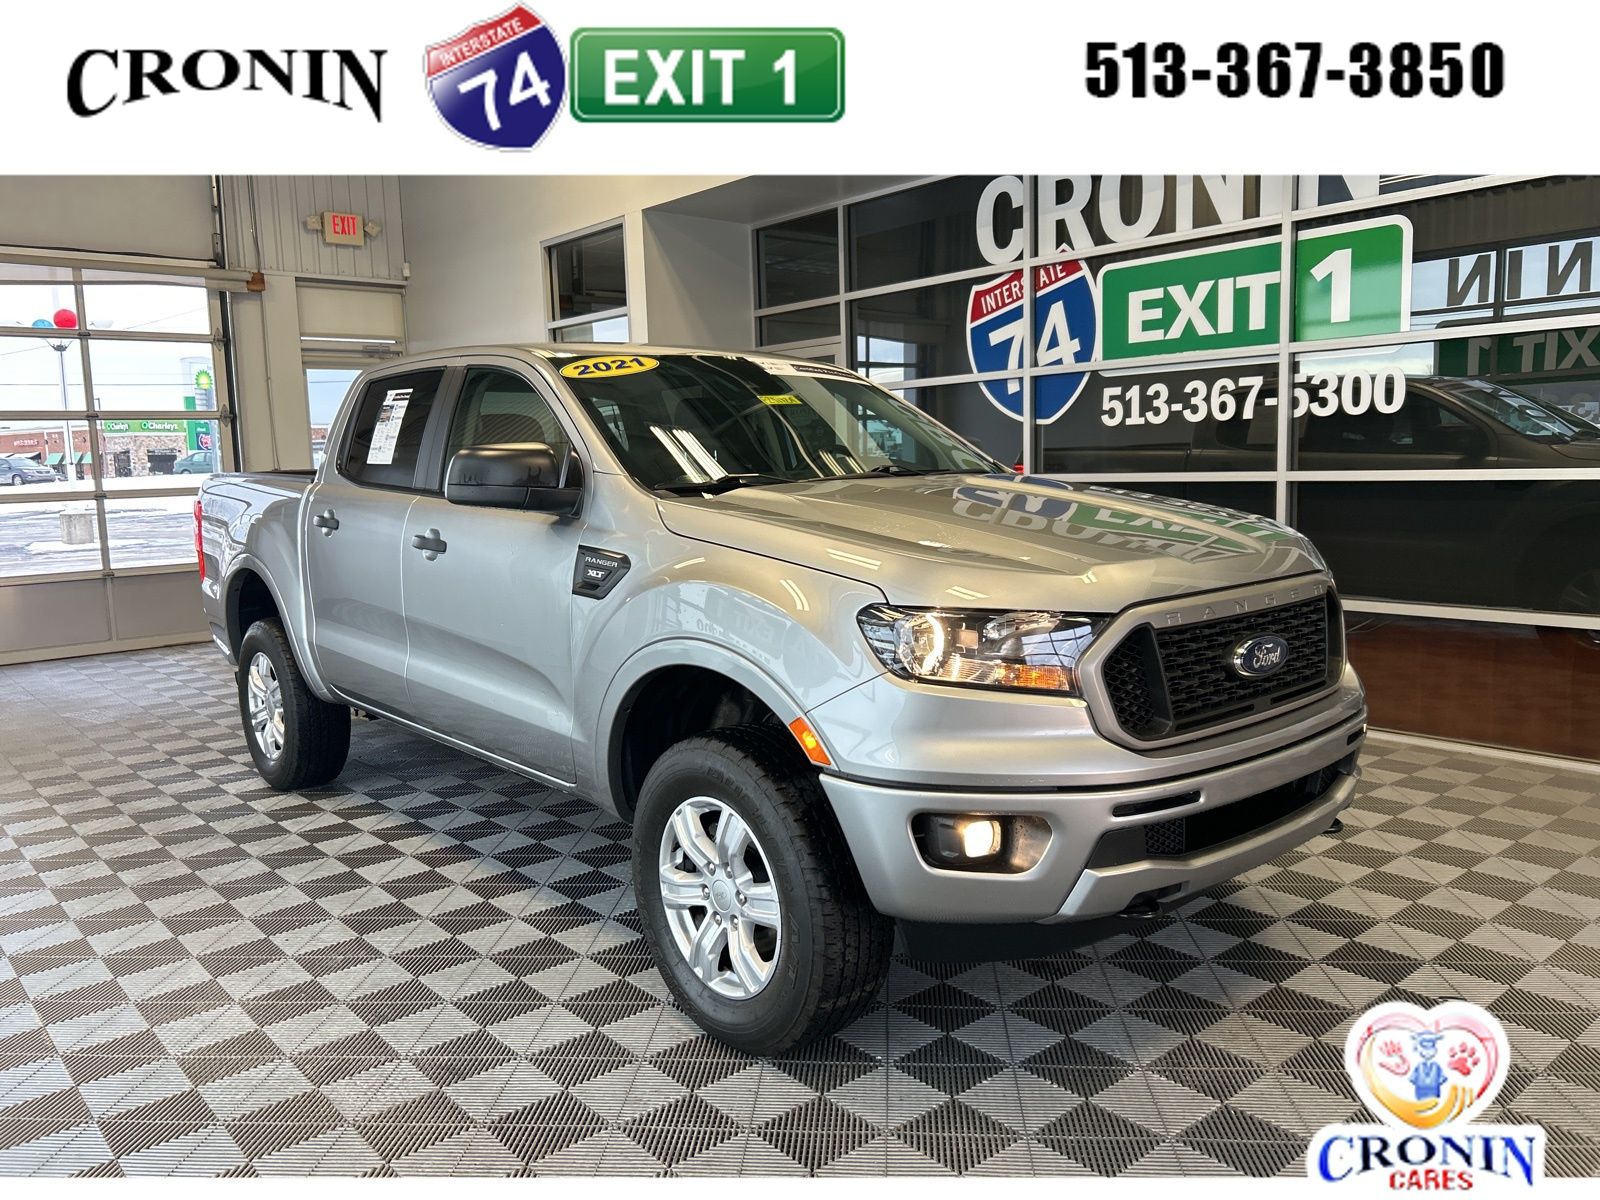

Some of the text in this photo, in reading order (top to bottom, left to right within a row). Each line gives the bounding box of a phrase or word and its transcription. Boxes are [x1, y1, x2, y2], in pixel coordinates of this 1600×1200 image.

[332, 214, 357, 235] EXIT
[981, 263, 1067, 314] INTERATE
[1128, 249, 1353, 343] EXIT 1
[988, 300, 1081, 395] 74
[573, 357, 646, 376] 2021
[585, 556, 618, 568] RANGER
[587, 569, 605, 578] XLT
[1253, 643, 1281, 669] Ford
